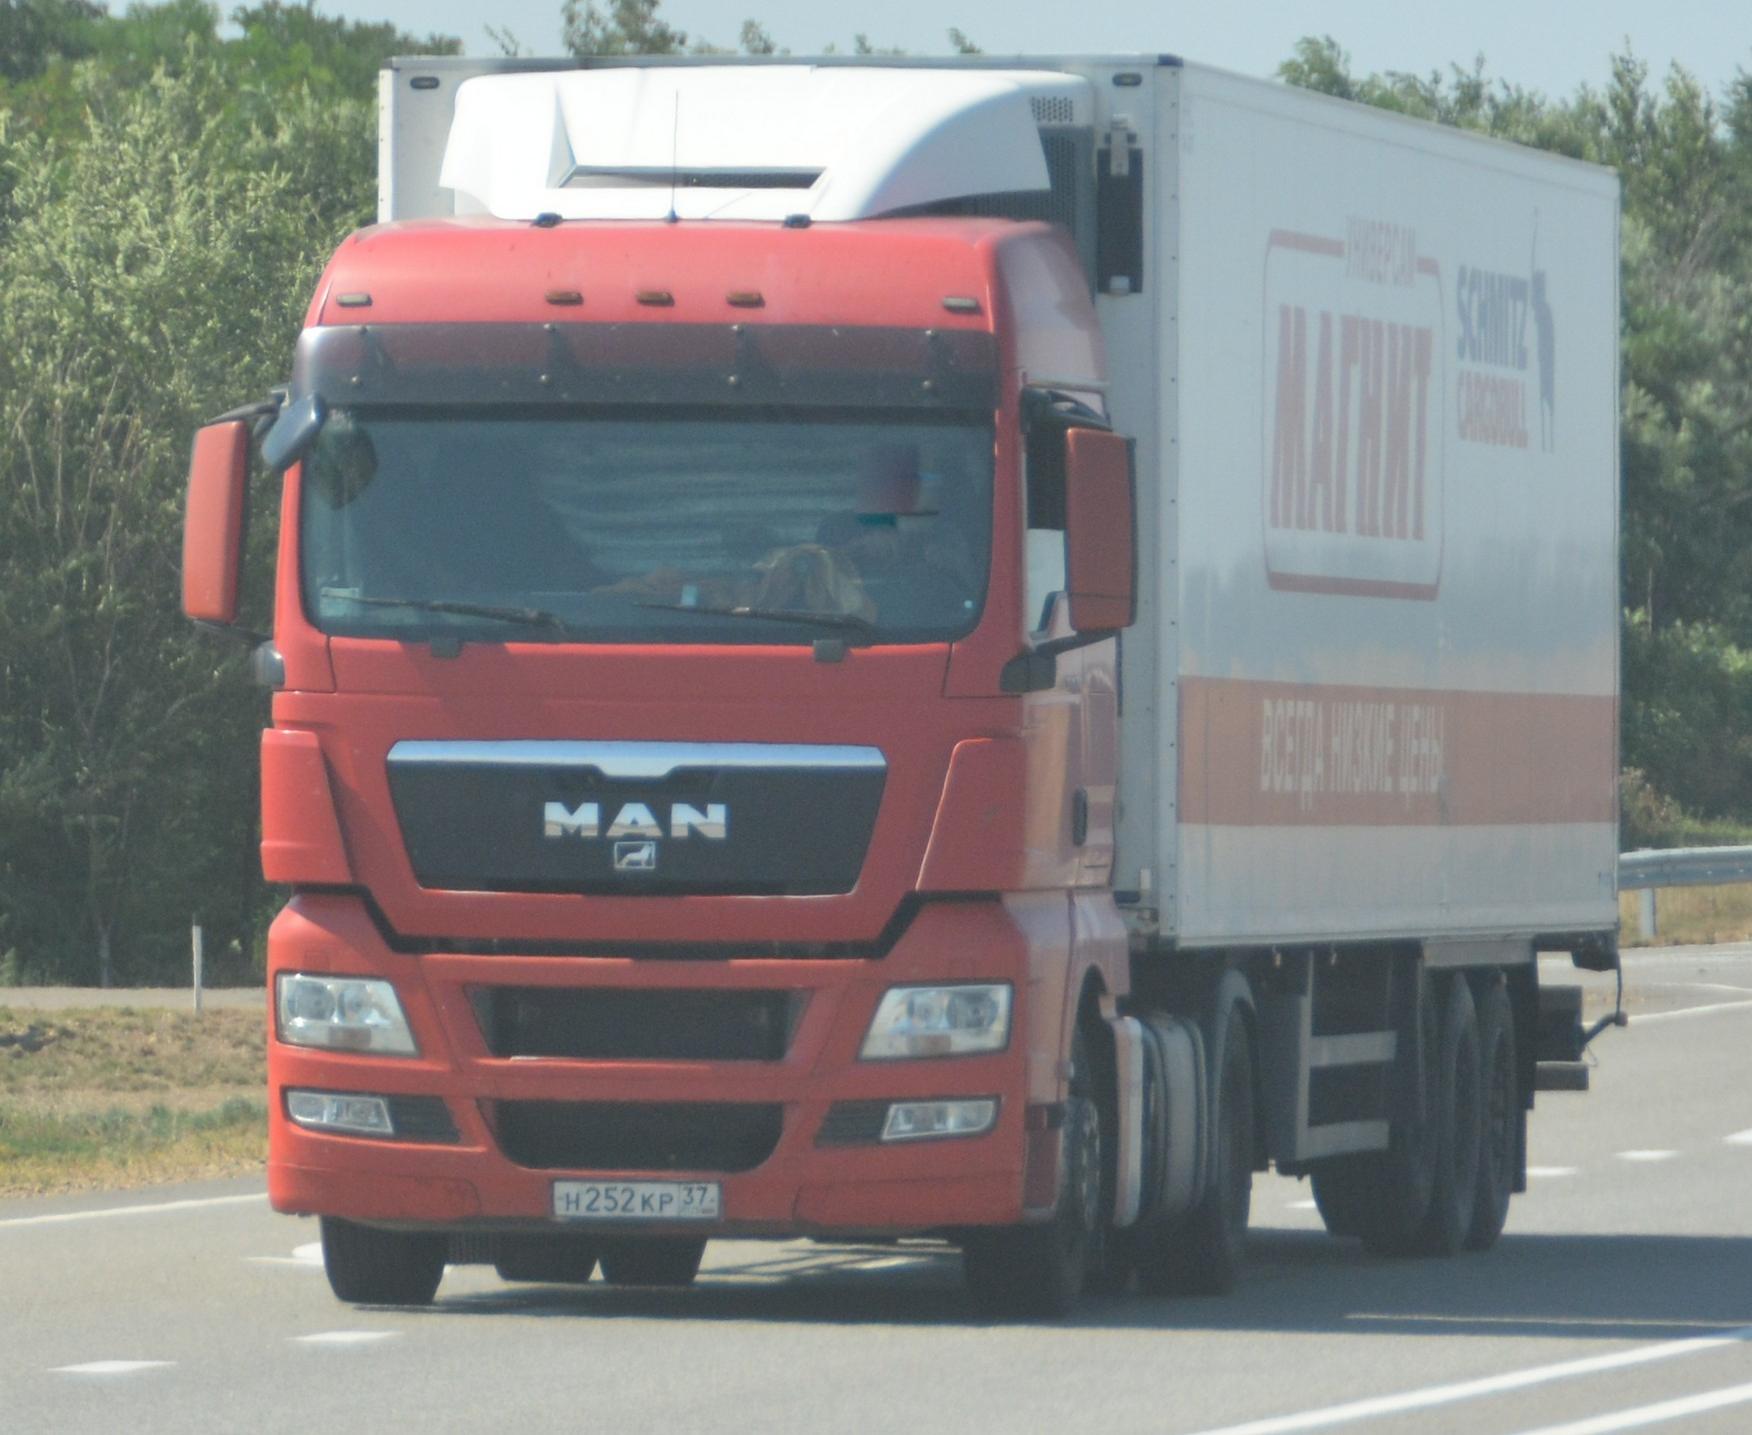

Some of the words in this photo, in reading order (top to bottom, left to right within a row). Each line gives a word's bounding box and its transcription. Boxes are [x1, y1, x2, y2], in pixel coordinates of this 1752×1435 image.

[1457, 264, 1528, 370] SCHMITZ
[1269, 303, 1433, 541] МАГНИТ
[1260, 698, 1324, 812] ВСЕГДА
[1330, 701, 1395, 793] НИЗКИЕ
[544, 801, 727, 839] MAN
